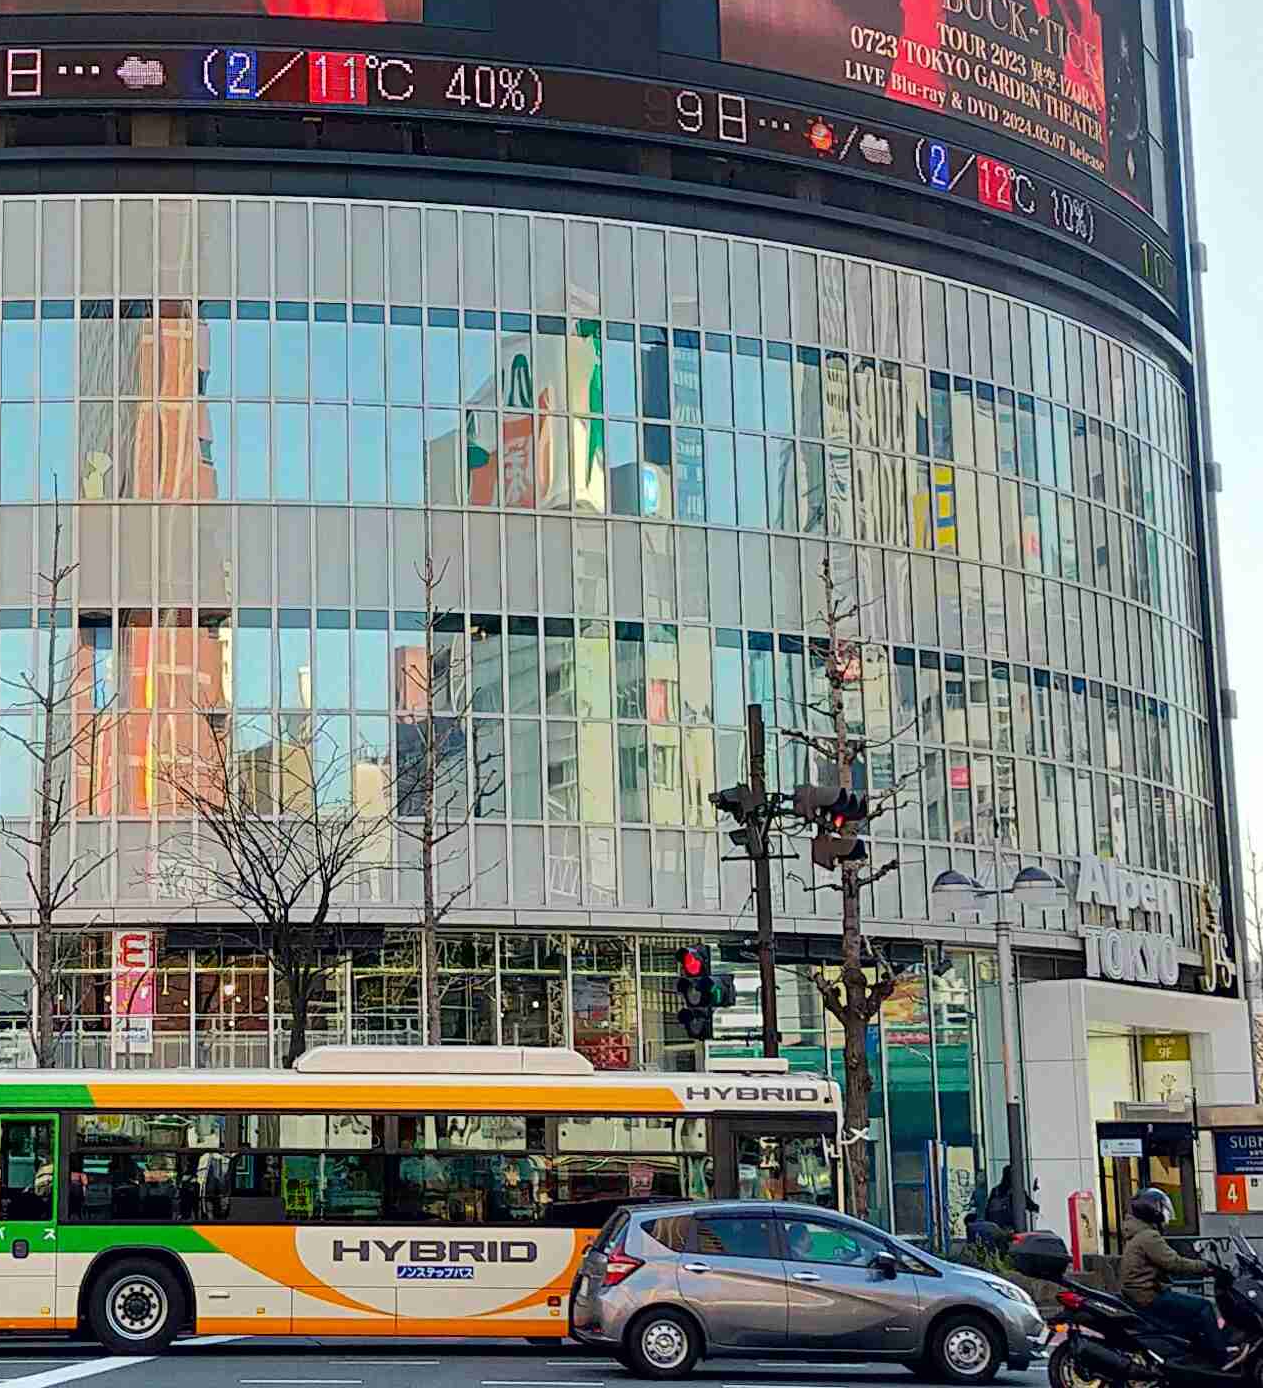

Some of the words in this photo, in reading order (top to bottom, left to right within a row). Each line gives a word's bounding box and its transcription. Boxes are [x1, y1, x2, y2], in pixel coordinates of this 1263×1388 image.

[936, 20, 989, 60] TOUR
[990, 42, 1028, 76] 2023
[844, 59, 886, 88] LIVE
[890, 72, 947, 106] Blu-ray
[950, 90, 963, 110] &
[967, 95, 1000, 123] DVD
[849, 25, 898, 59] 0723
[901, 38, 971, 81] TOKYO
[974, 64, 1041, 112] GARDEN
[1043, 91, 1103, 145] THEATER
[1076, 852, 1176, 921] Alpen
[687, 1086, 819, 1102] HYBRID
[1226, 1183, 1239, 1204] 4
[332, 1239, 538, 1263] HYBRID
[398, 1266, 474, 1279] ノンステップバス
